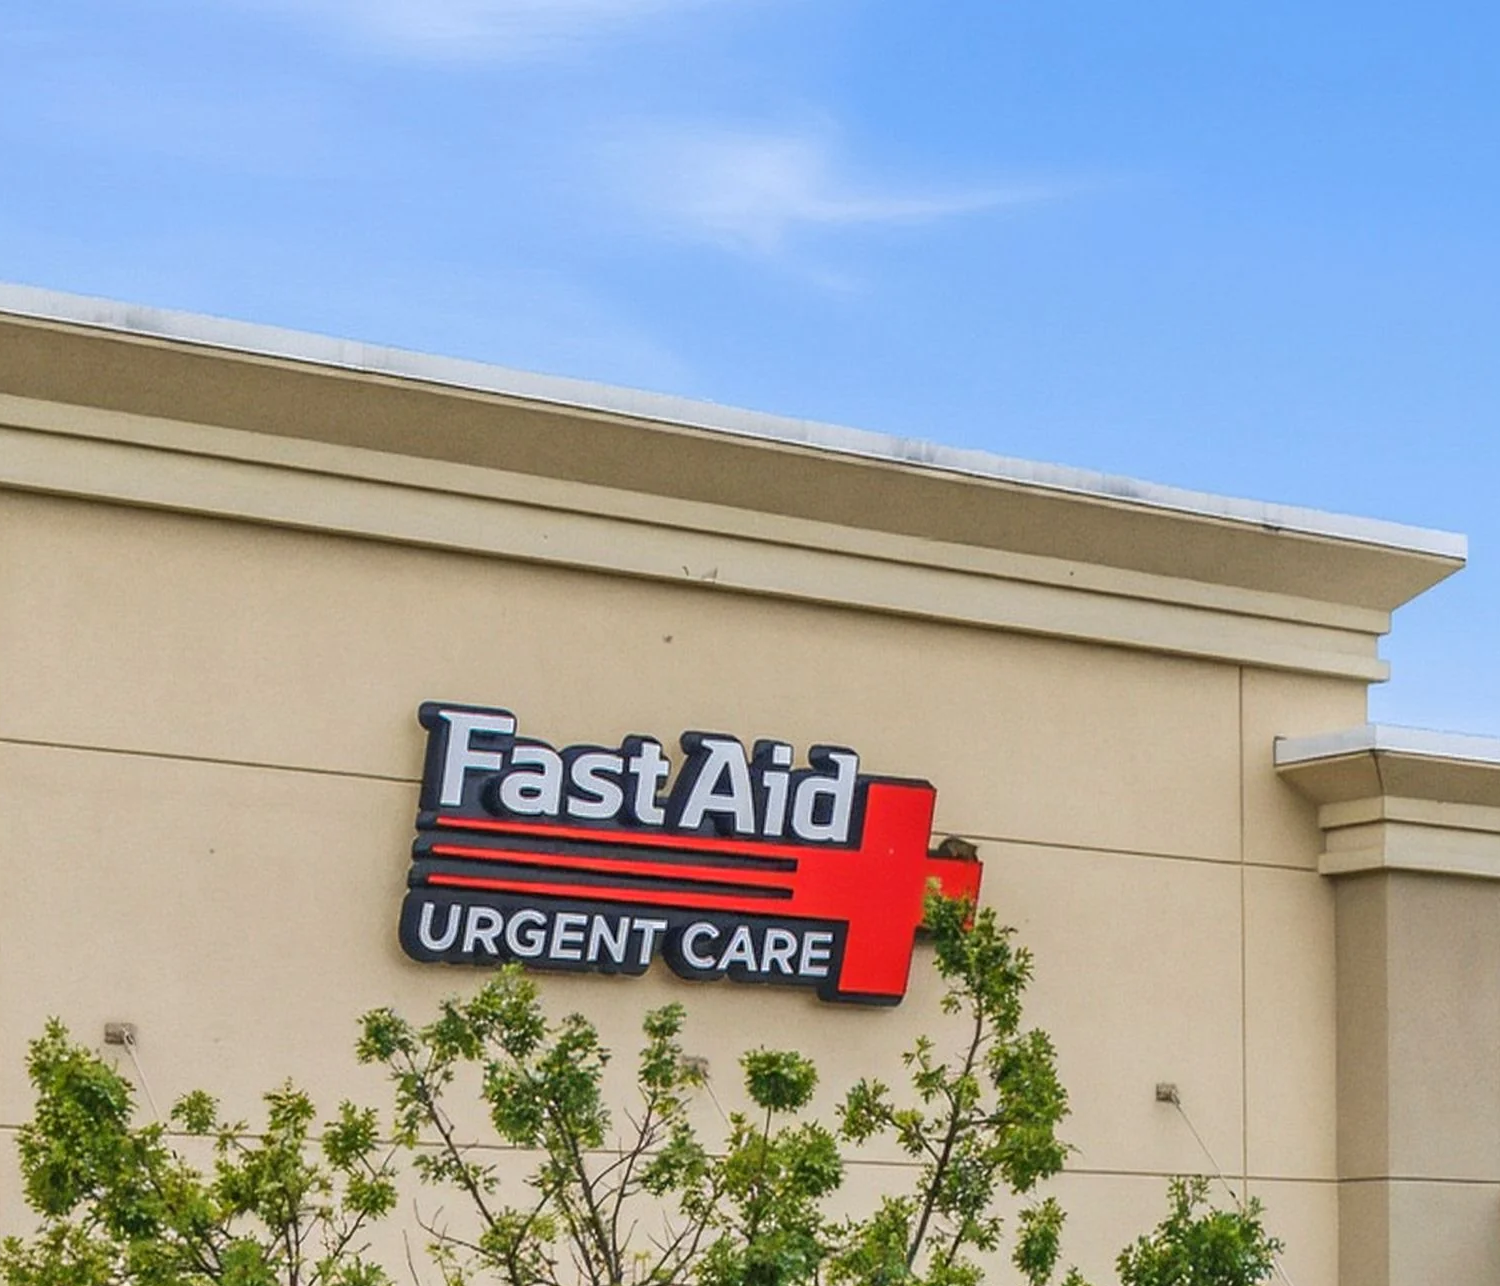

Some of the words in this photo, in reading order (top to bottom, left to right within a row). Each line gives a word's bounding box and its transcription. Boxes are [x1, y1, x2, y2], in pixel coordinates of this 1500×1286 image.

[438, 711, 669, 826] Fast
[679, 738, 859, 843] Aid
[417, 902, 668, 966] URGENT
[681, 921, 834, 977] CARE
